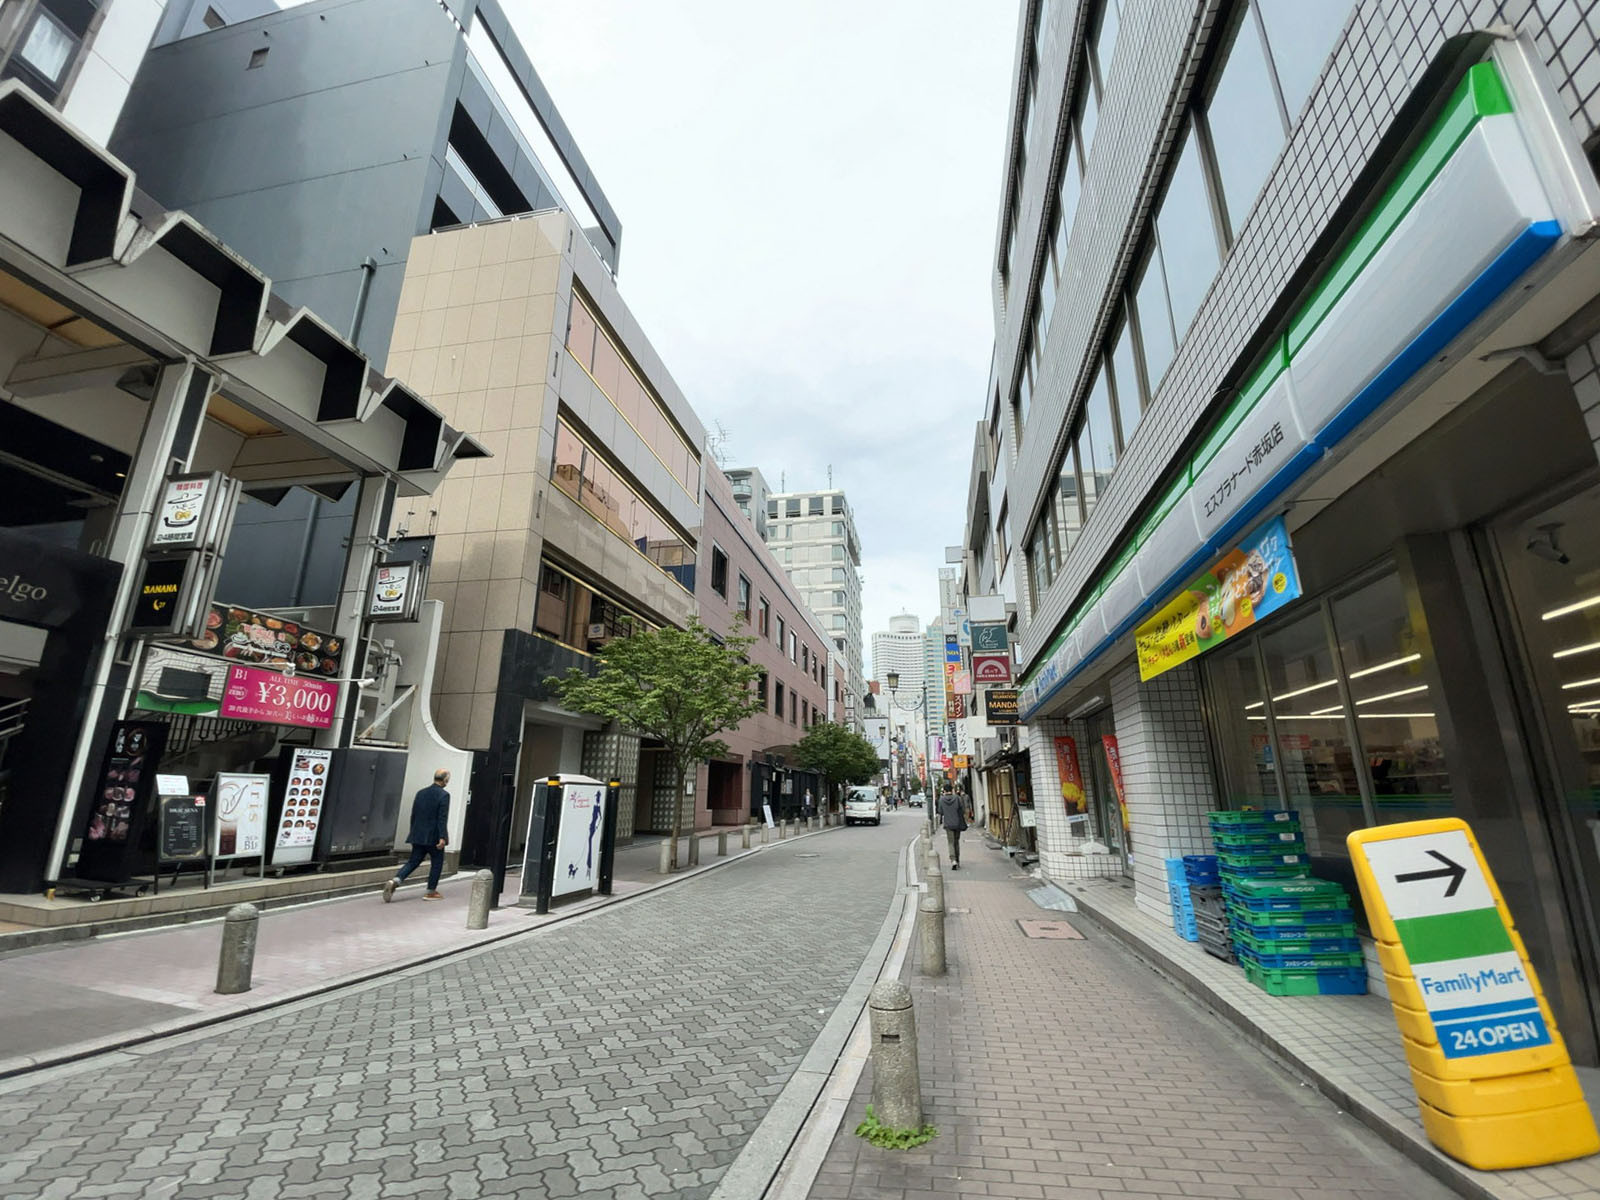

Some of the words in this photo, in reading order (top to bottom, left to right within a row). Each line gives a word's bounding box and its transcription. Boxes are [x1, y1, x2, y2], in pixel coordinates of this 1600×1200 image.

[1204, 421, 1284, 518] エスプラナード赤坂店
[143, 583, 177, 594] BANANA
[234, 668, 248, 680] B1
[258, 681, 331, 712] ¥3,000
[1420, 966, 1525, 996] FamilyMart
